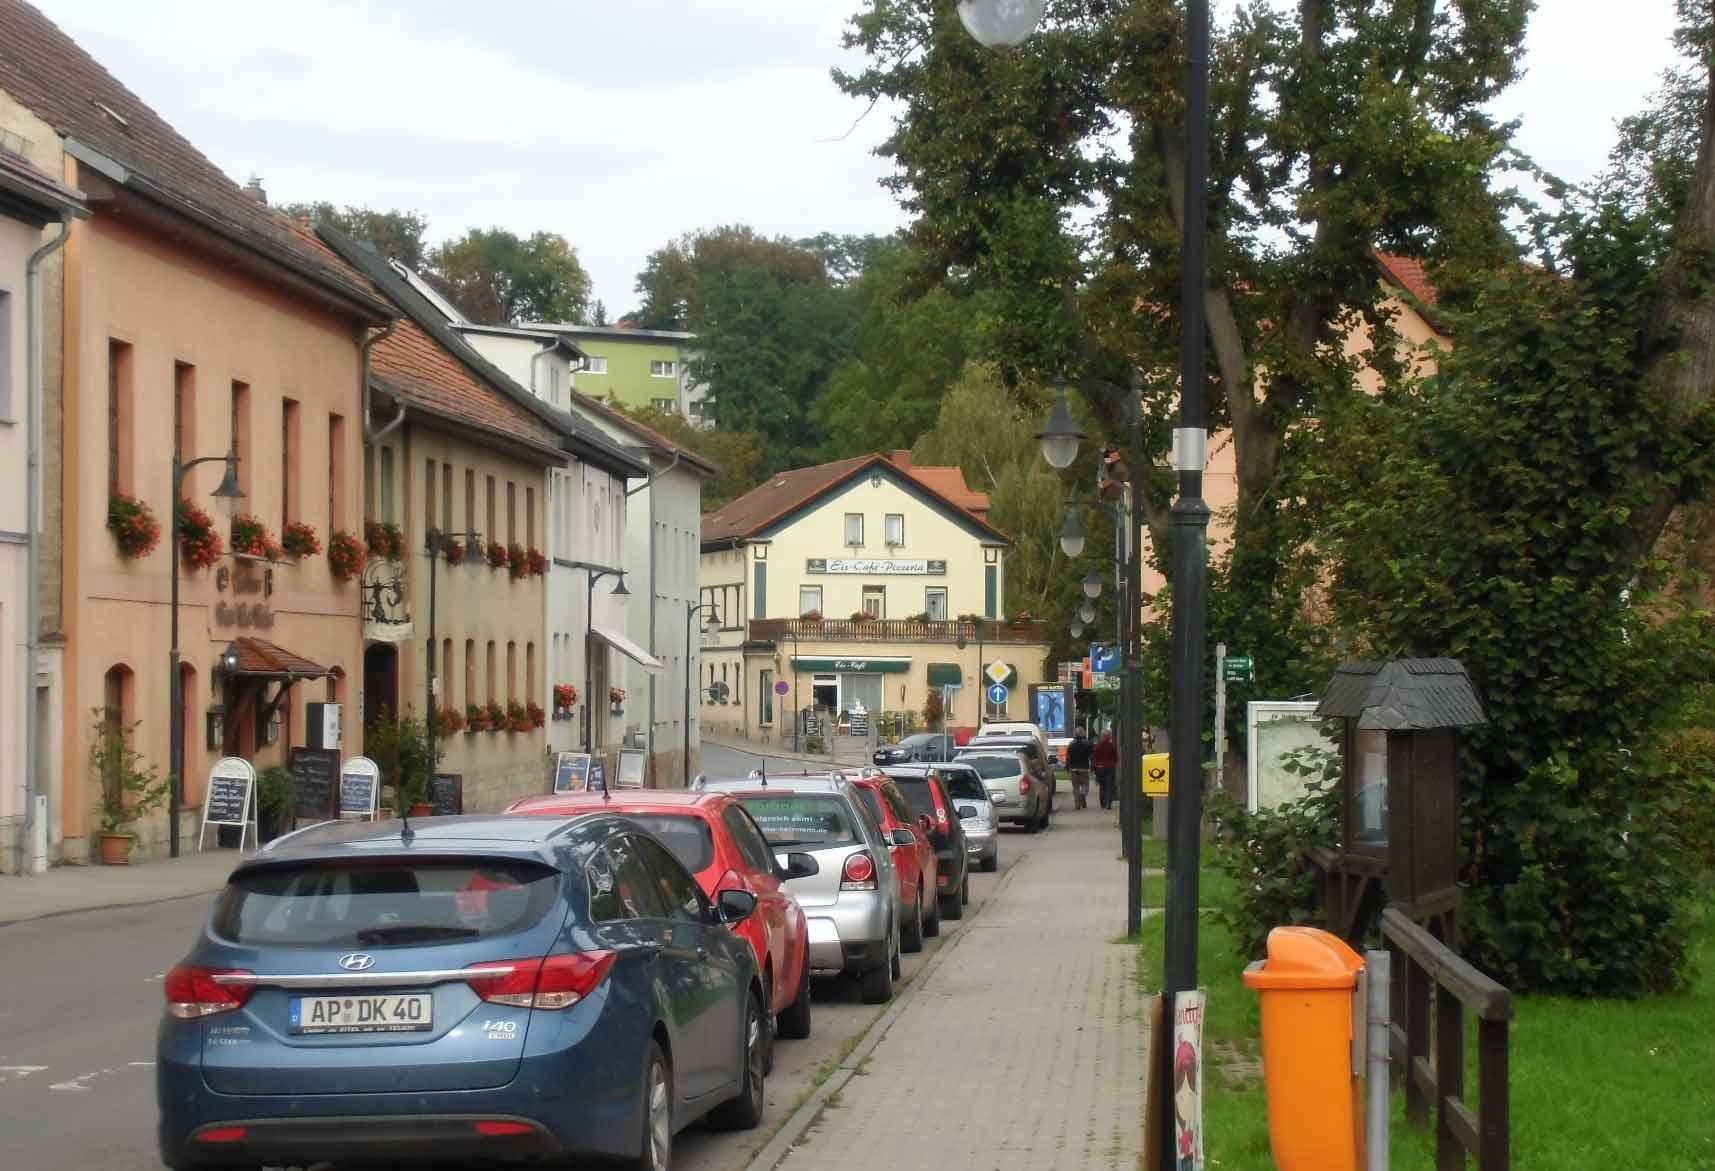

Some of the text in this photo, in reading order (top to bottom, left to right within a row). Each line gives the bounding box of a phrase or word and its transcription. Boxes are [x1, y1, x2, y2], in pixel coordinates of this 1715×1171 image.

[311, 997, 421, 1022] AP DK 40
[483, 1020, 516, 1032] i40
